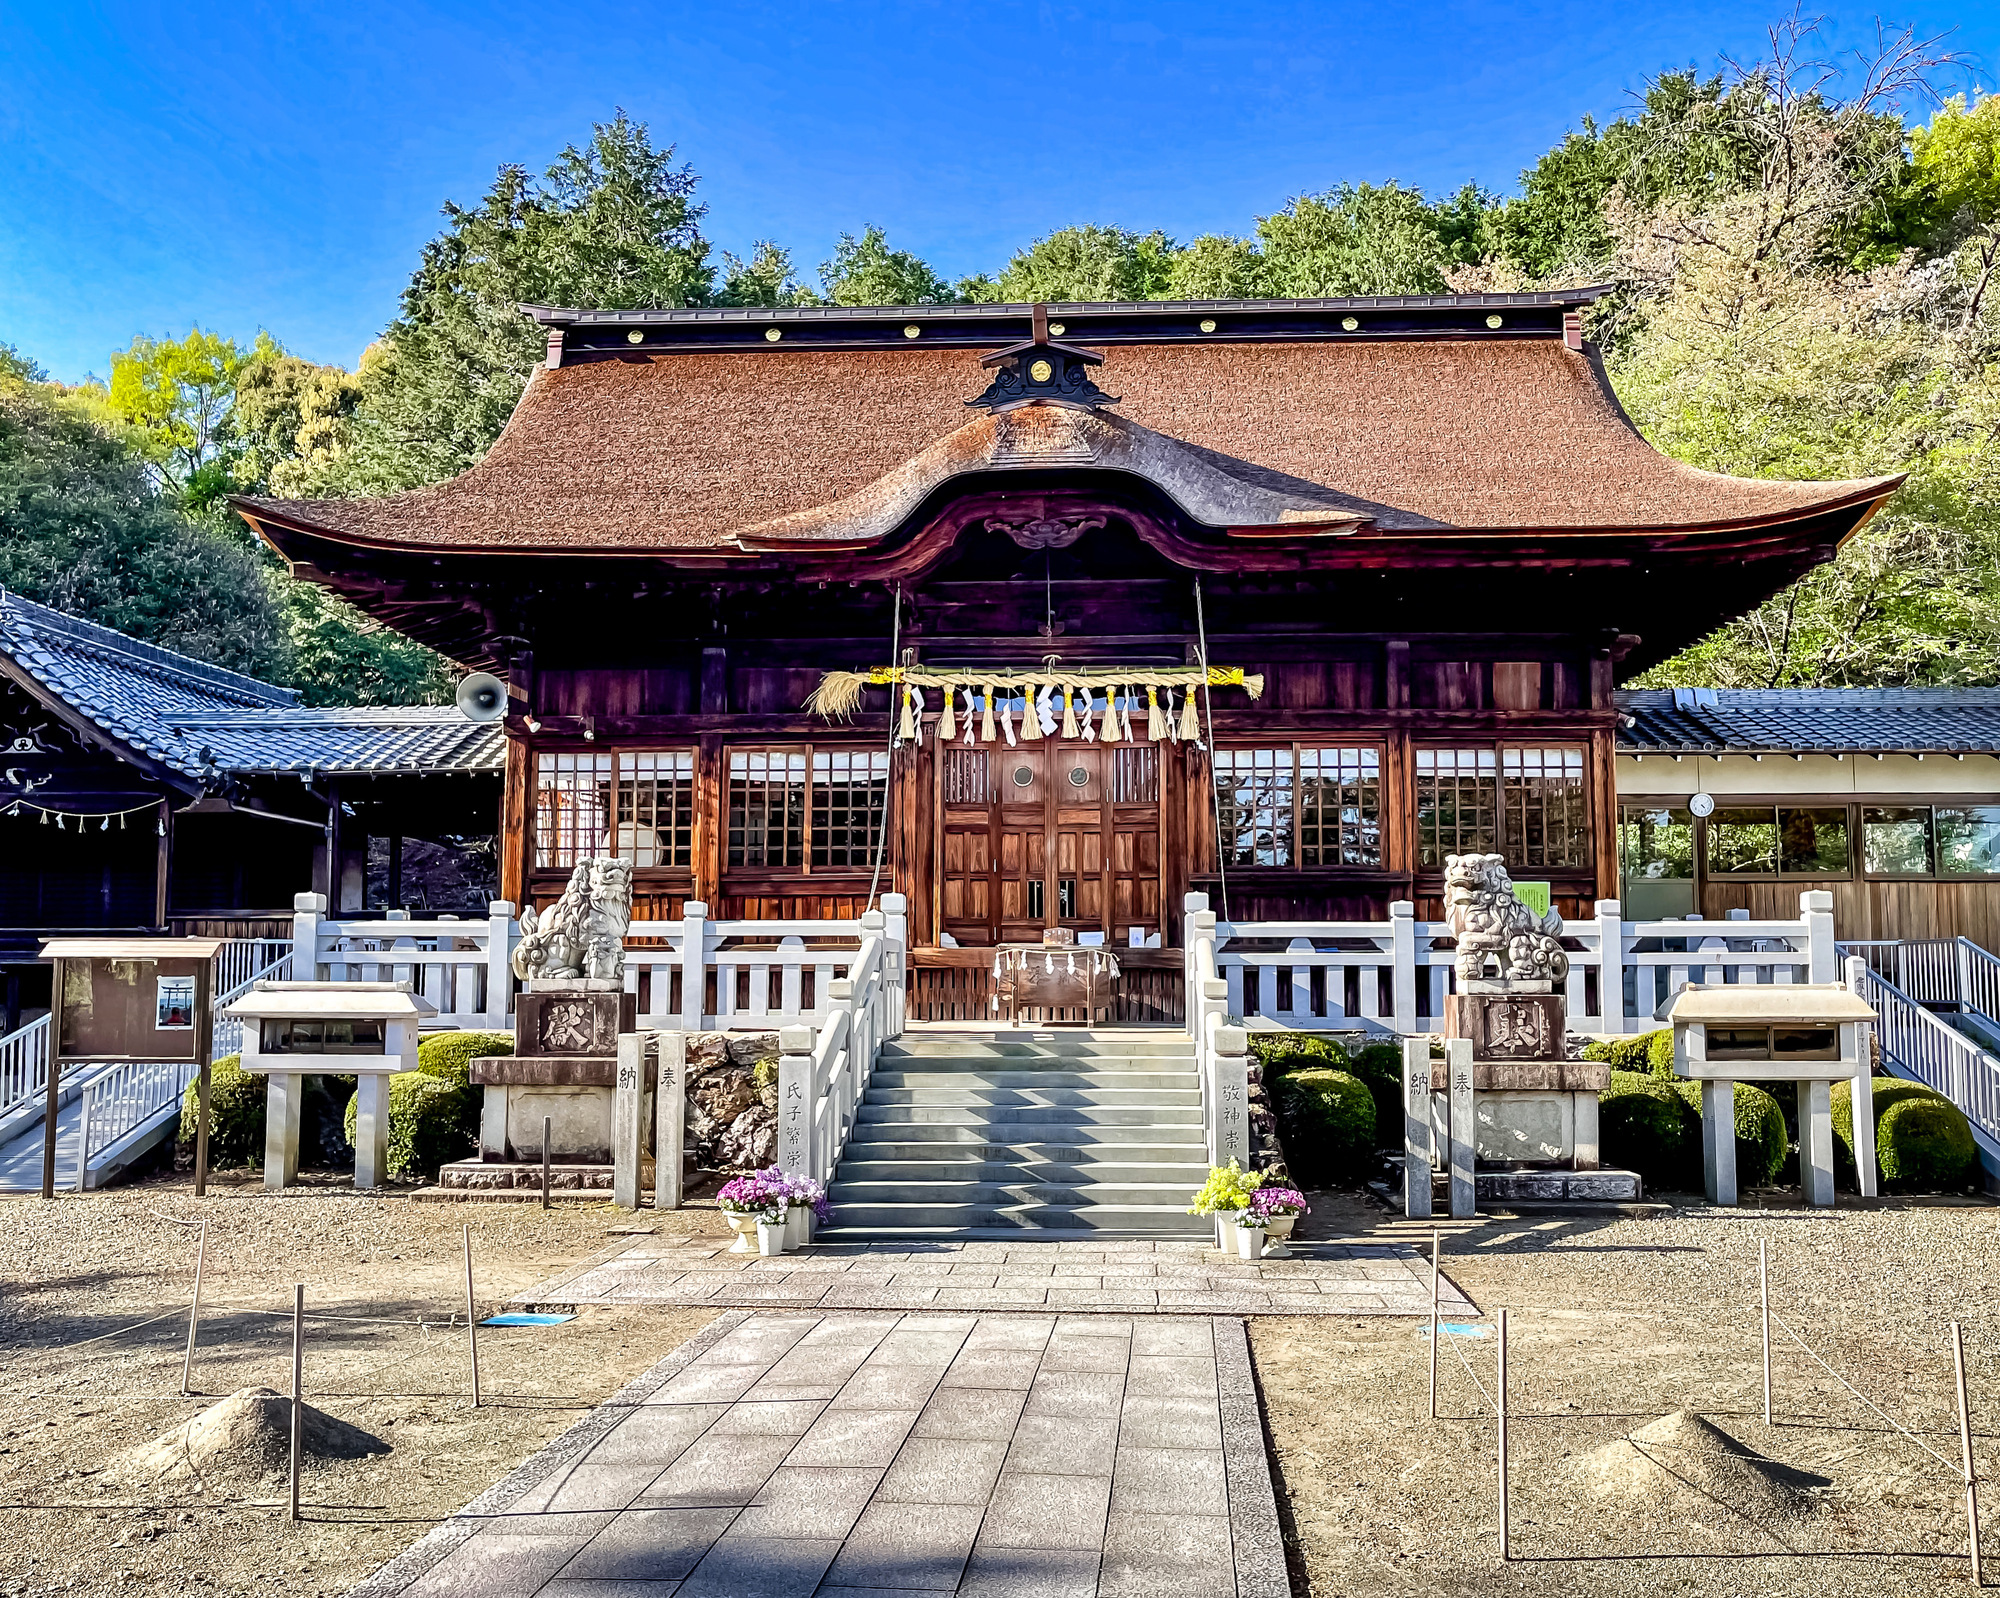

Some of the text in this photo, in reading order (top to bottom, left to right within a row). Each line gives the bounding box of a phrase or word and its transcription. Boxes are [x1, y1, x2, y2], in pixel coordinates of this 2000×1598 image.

[619, 1067, 637, 1089] 納
[661, 1067, 676, 1090] 奉
[1410, 1072, 1429, 1095] 納
[1453, 1072, 1471, 1096] 奉
[786, 1082, 802, 1166] 氏子繁栄
